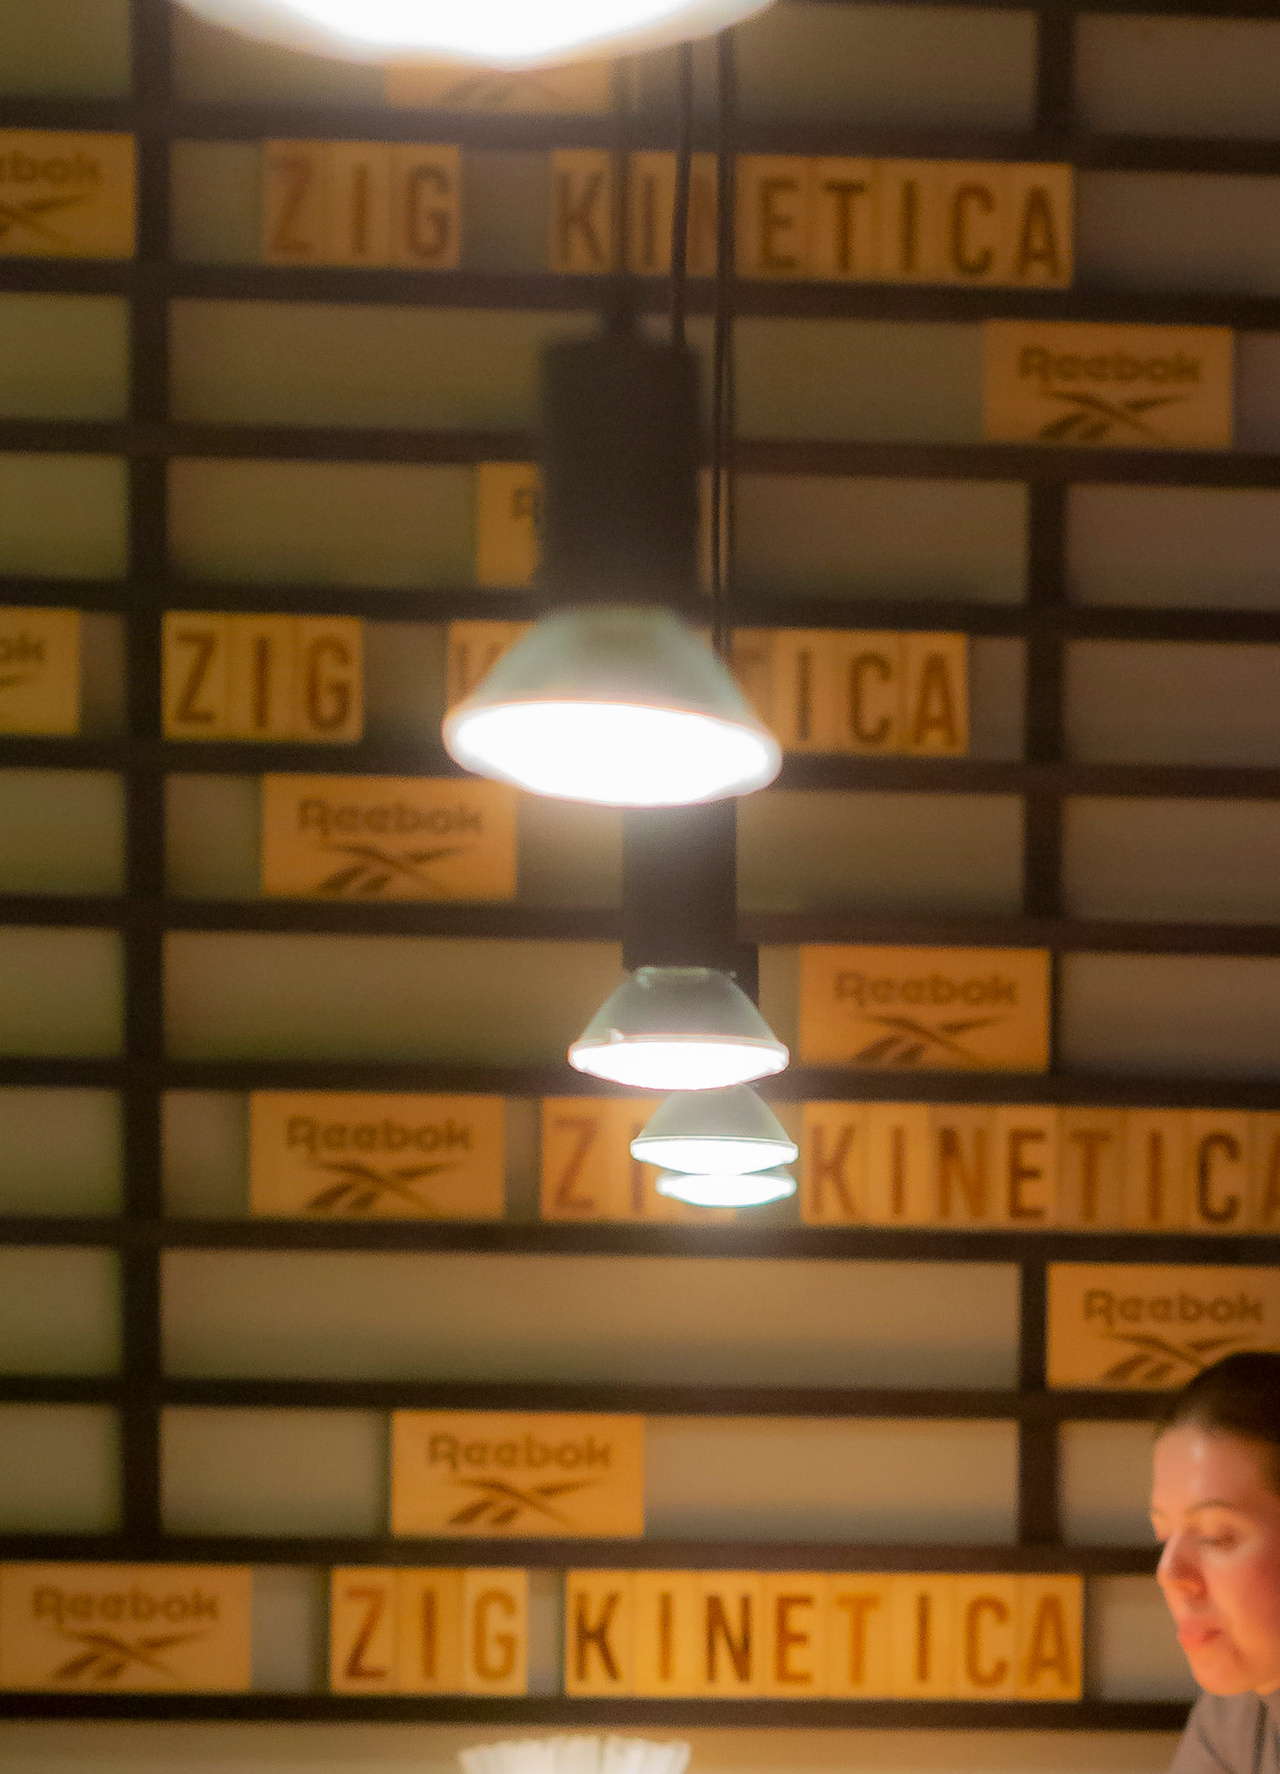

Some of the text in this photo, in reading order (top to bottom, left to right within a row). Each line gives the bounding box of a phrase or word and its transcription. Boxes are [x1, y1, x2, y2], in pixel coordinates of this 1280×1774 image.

[266, 159, 452, 262] ZIG
[1016, 344, 1202, 386] Reebok
[174, 630, 355, 731] ZIG
[298, 797, 484, 838] Reebok
[833, 968, 1018, 1008] Reebok
[285, 1115, 471, 1154] Reebok
[1083, 1289, 1265, 1328] Reebok
[427, 1433, 613, 1472] Reebok
[31, 1585, 219, 1625] Reebok
[343, 1587, 1075, 1689] ZIG KINETICA
